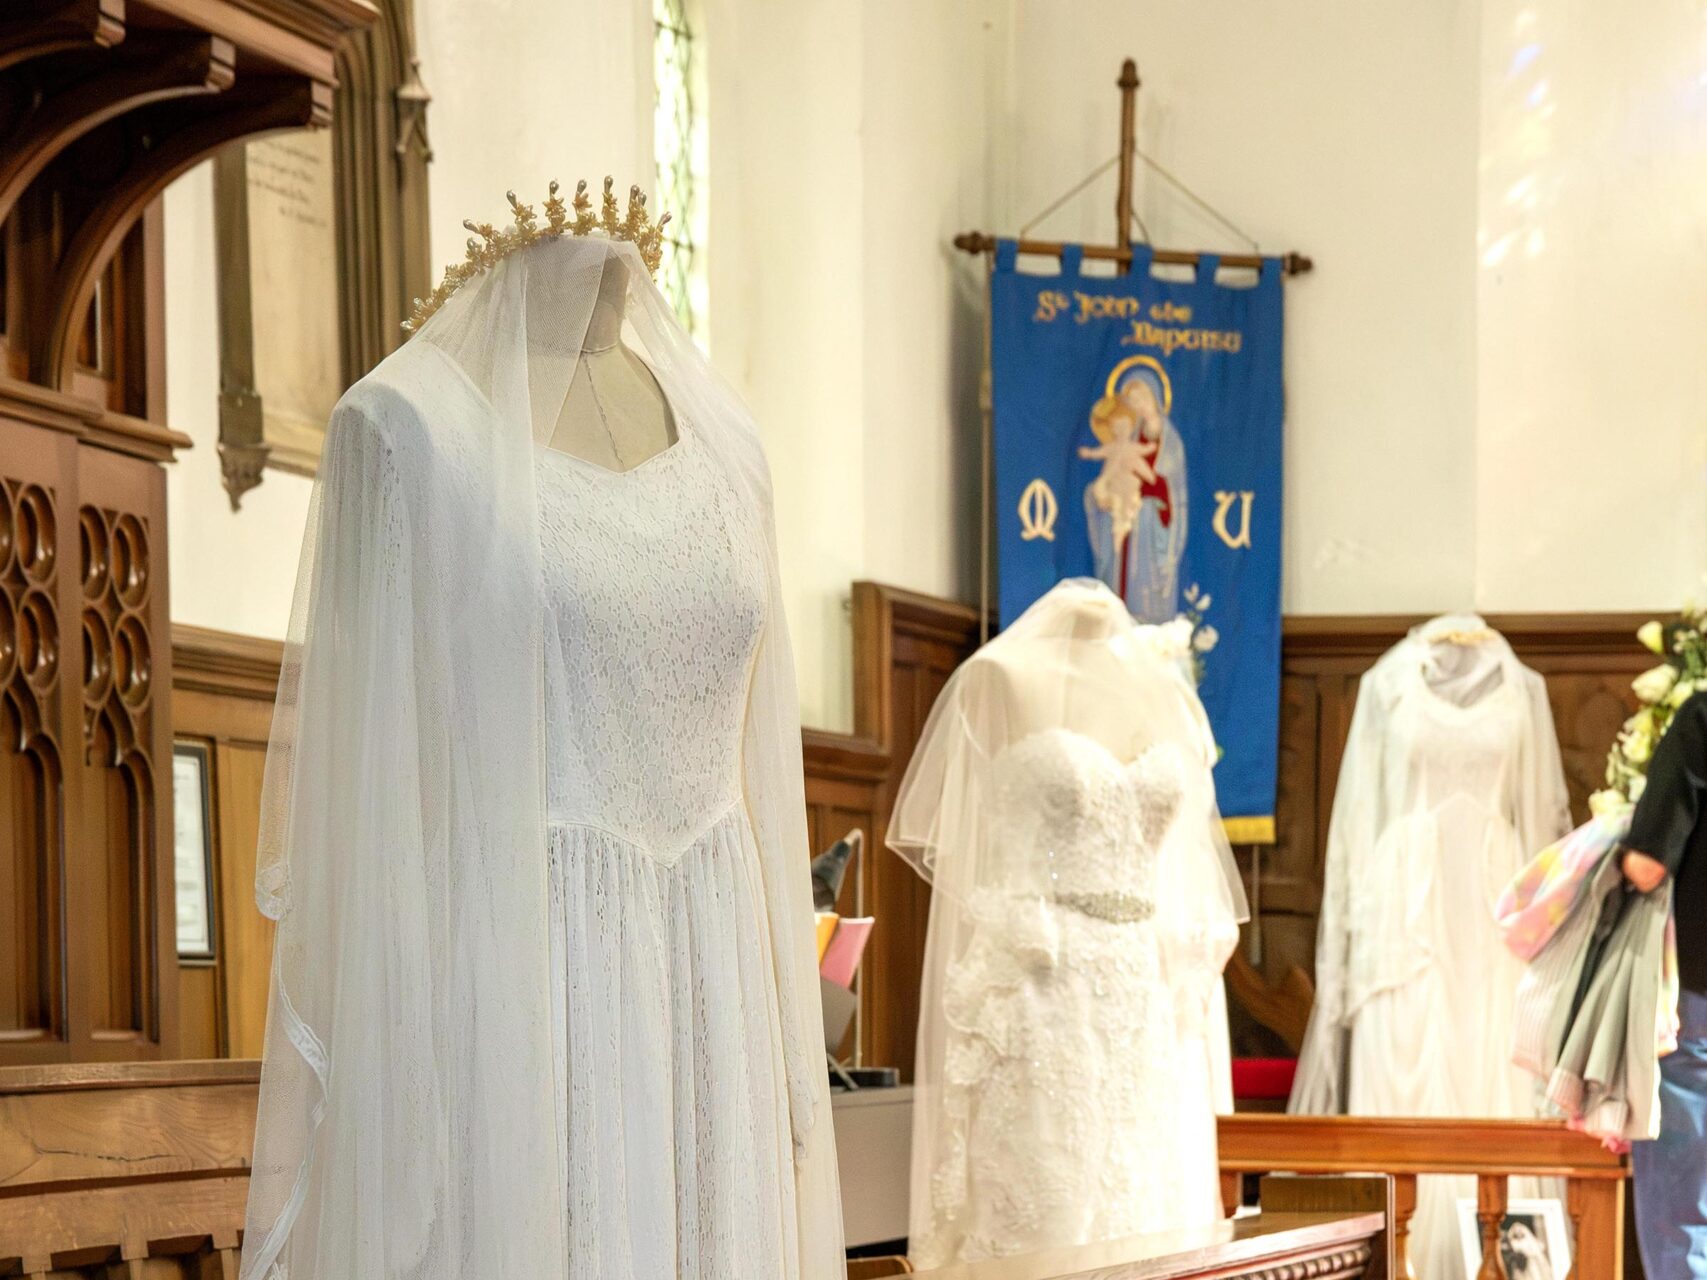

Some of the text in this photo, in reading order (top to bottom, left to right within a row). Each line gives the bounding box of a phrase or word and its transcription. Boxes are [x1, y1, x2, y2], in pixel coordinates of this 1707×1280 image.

[1074, 289, 1140, 324] John
[1149, 300, 1193, 323] the
[1211, 489, 1255, 550] U
